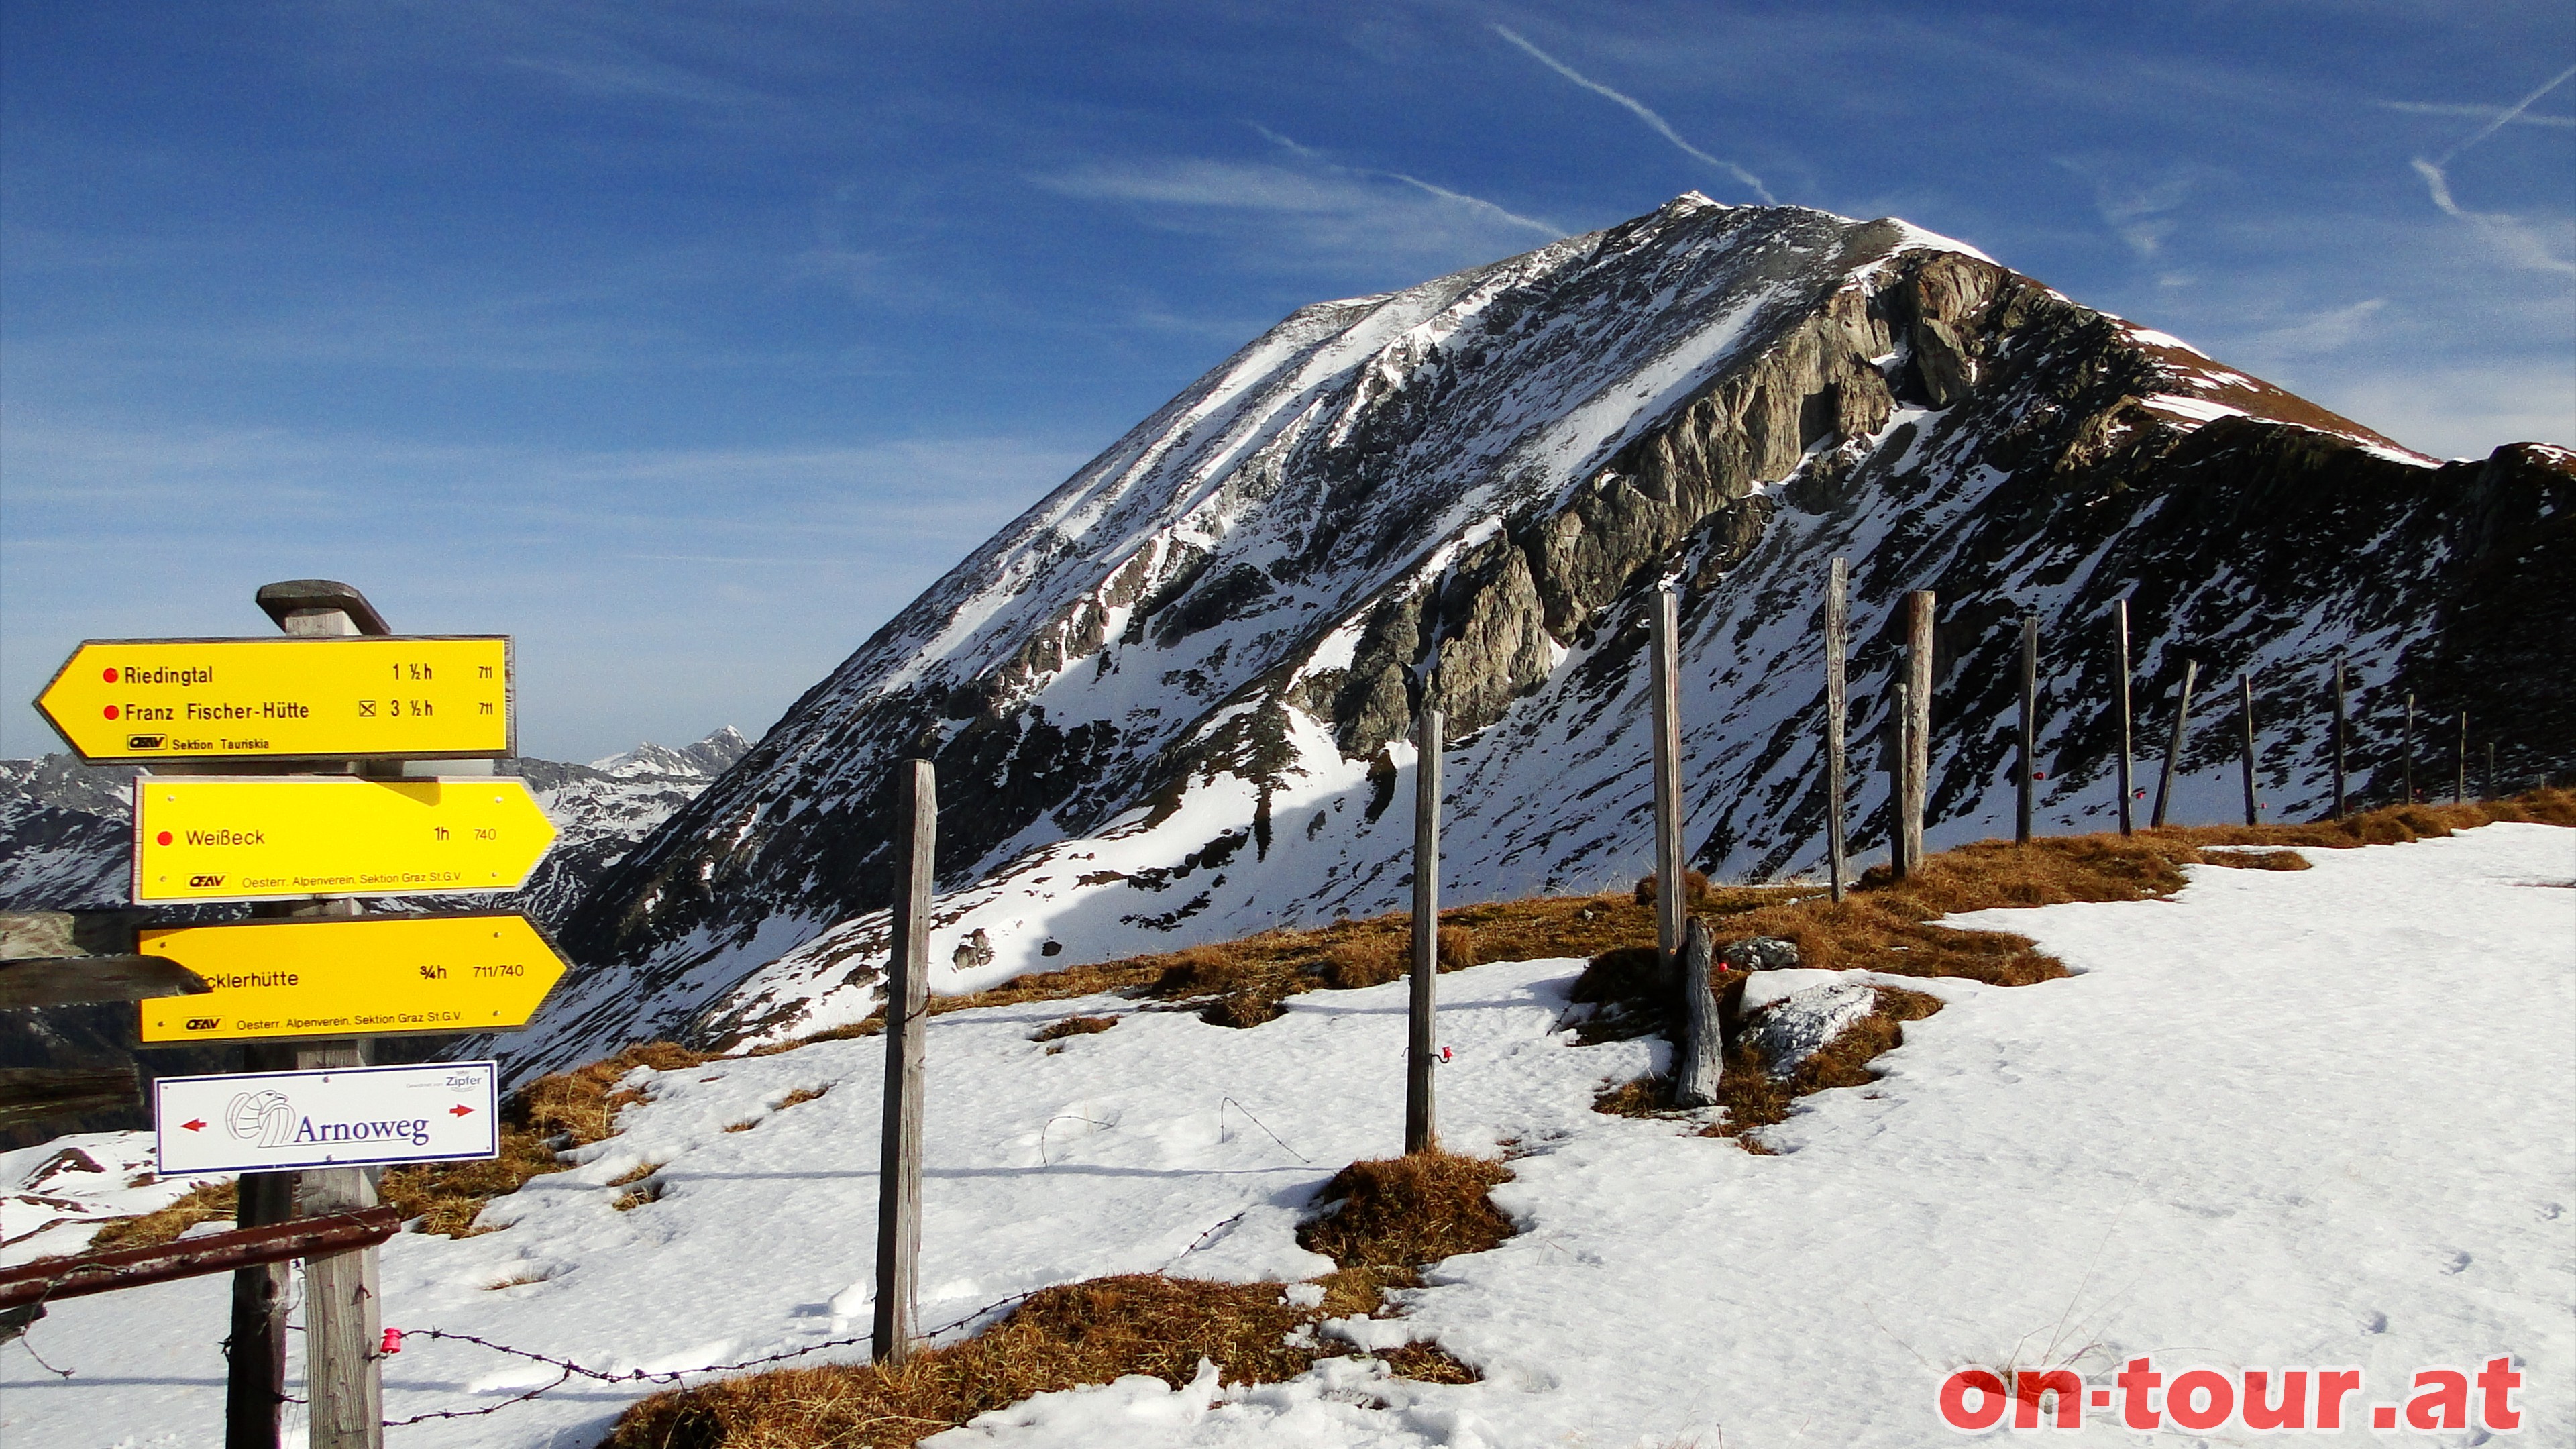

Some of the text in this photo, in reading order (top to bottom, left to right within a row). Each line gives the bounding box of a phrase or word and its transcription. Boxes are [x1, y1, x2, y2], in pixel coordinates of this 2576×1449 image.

[125, 666, 213, 686] Riedingtal
[392, 663, 400, 680] 1
[478, 666, 492, 678] 711
[125, 704, 174, 720] Franz
[186, 702, 309, 720] Fischer-Hütte
[391, 700, 400, 716] 3
[479, 702, 493, 715] 711
[172, 739, 213, 750] Sektion
[221, 739, 269, 749] Tauriskia
[186, 829, 266, 846] Weißeck
[474, 828, 496, 841] 740
[242, 877, 289, 888] Oesterr.
[360, 874, 399, 884] Sektion
[402, 873, 426, 883] Graz
[201, 971, 299, 989] cklerhütte
[473, 964, 524, 977] 711/740
[237, 1020, 283, 1030] Oesterr.
[354, 1015, 395, 1025] Sektion
[398, 1013, 423, 1023] Graz
[445, 1075, 482, 1087] Zipfer
[294, 1115, 430, 1146] Arnoweg
